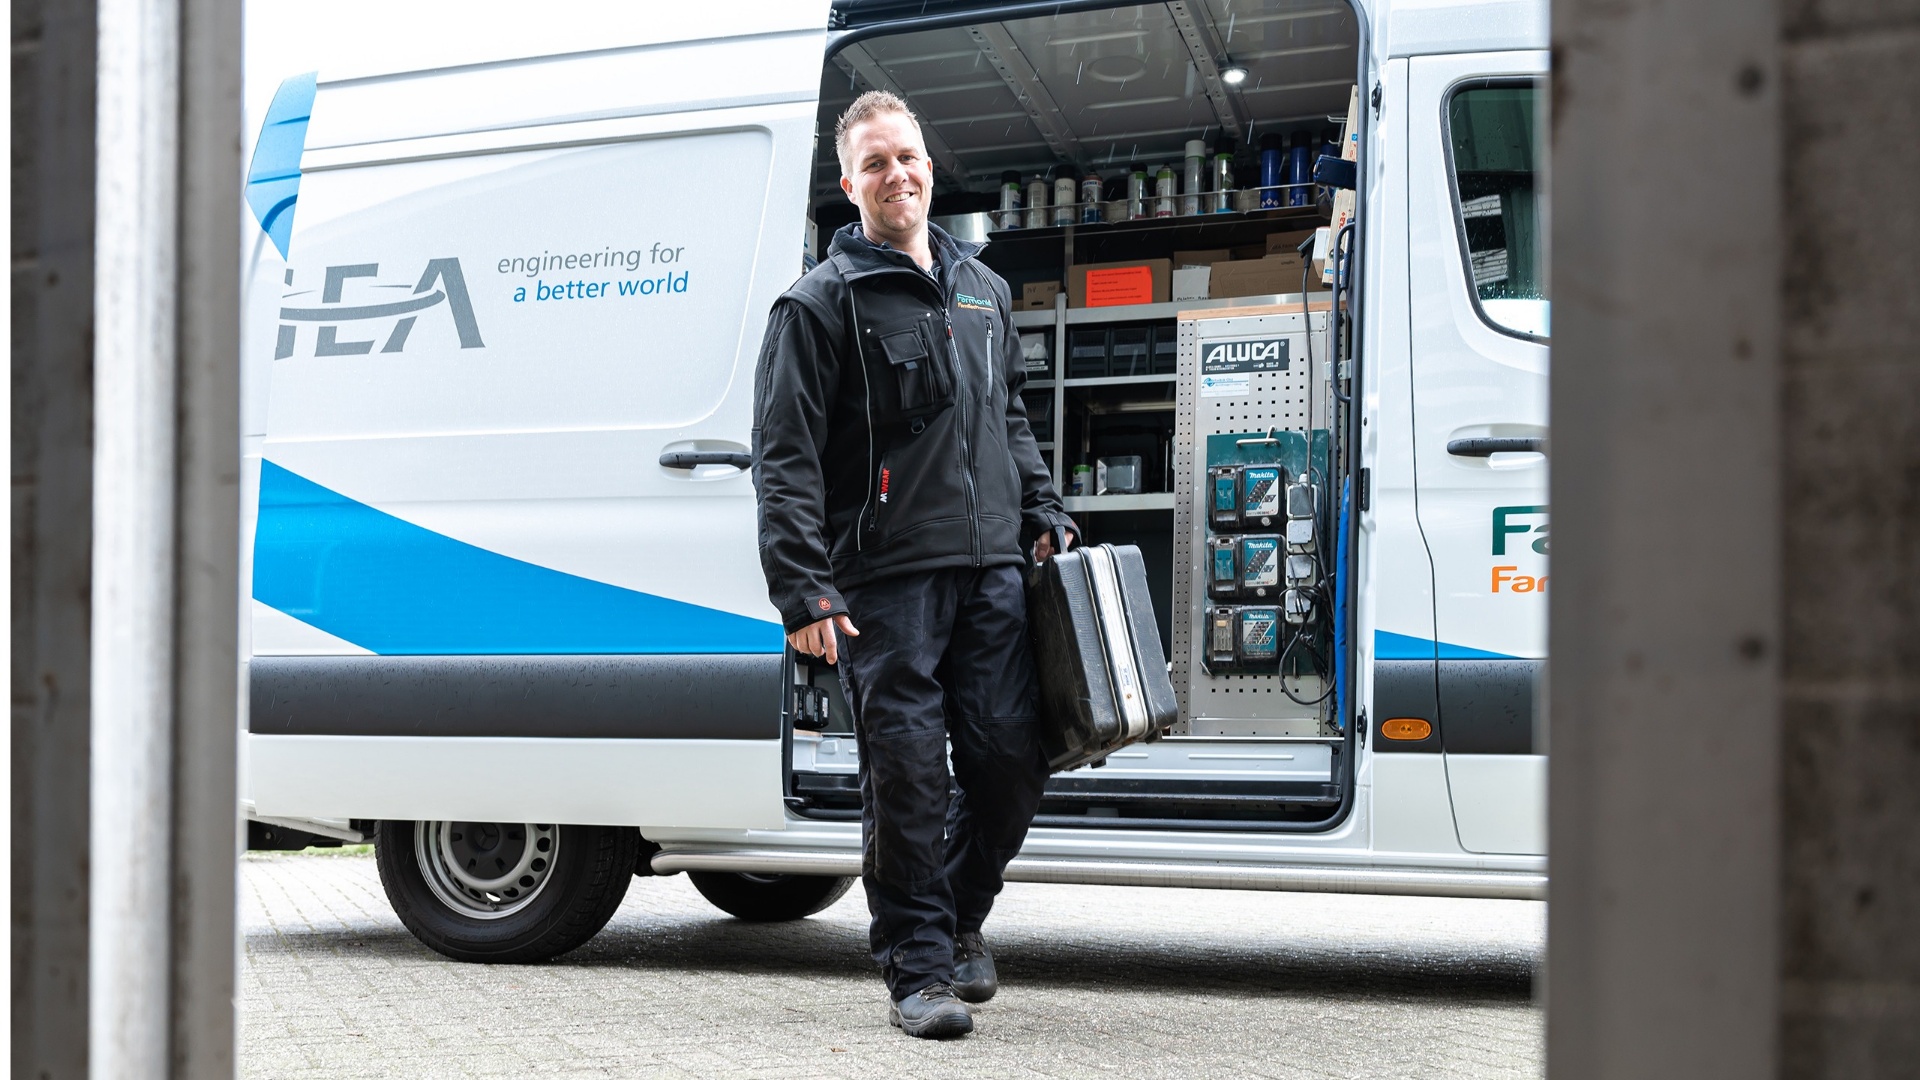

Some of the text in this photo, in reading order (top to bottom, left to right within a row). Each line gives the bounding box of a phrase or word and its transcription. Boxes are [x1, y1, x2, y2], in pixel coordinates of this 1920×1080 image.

[497, 242, 685, 278] engineering for
[513, 270, 689, 302] a better world
[1205, 341, 1280, 363] ALUCA
[1248, 471, 1275, 479] makita
[1247, 541, 1274, 549] makita
